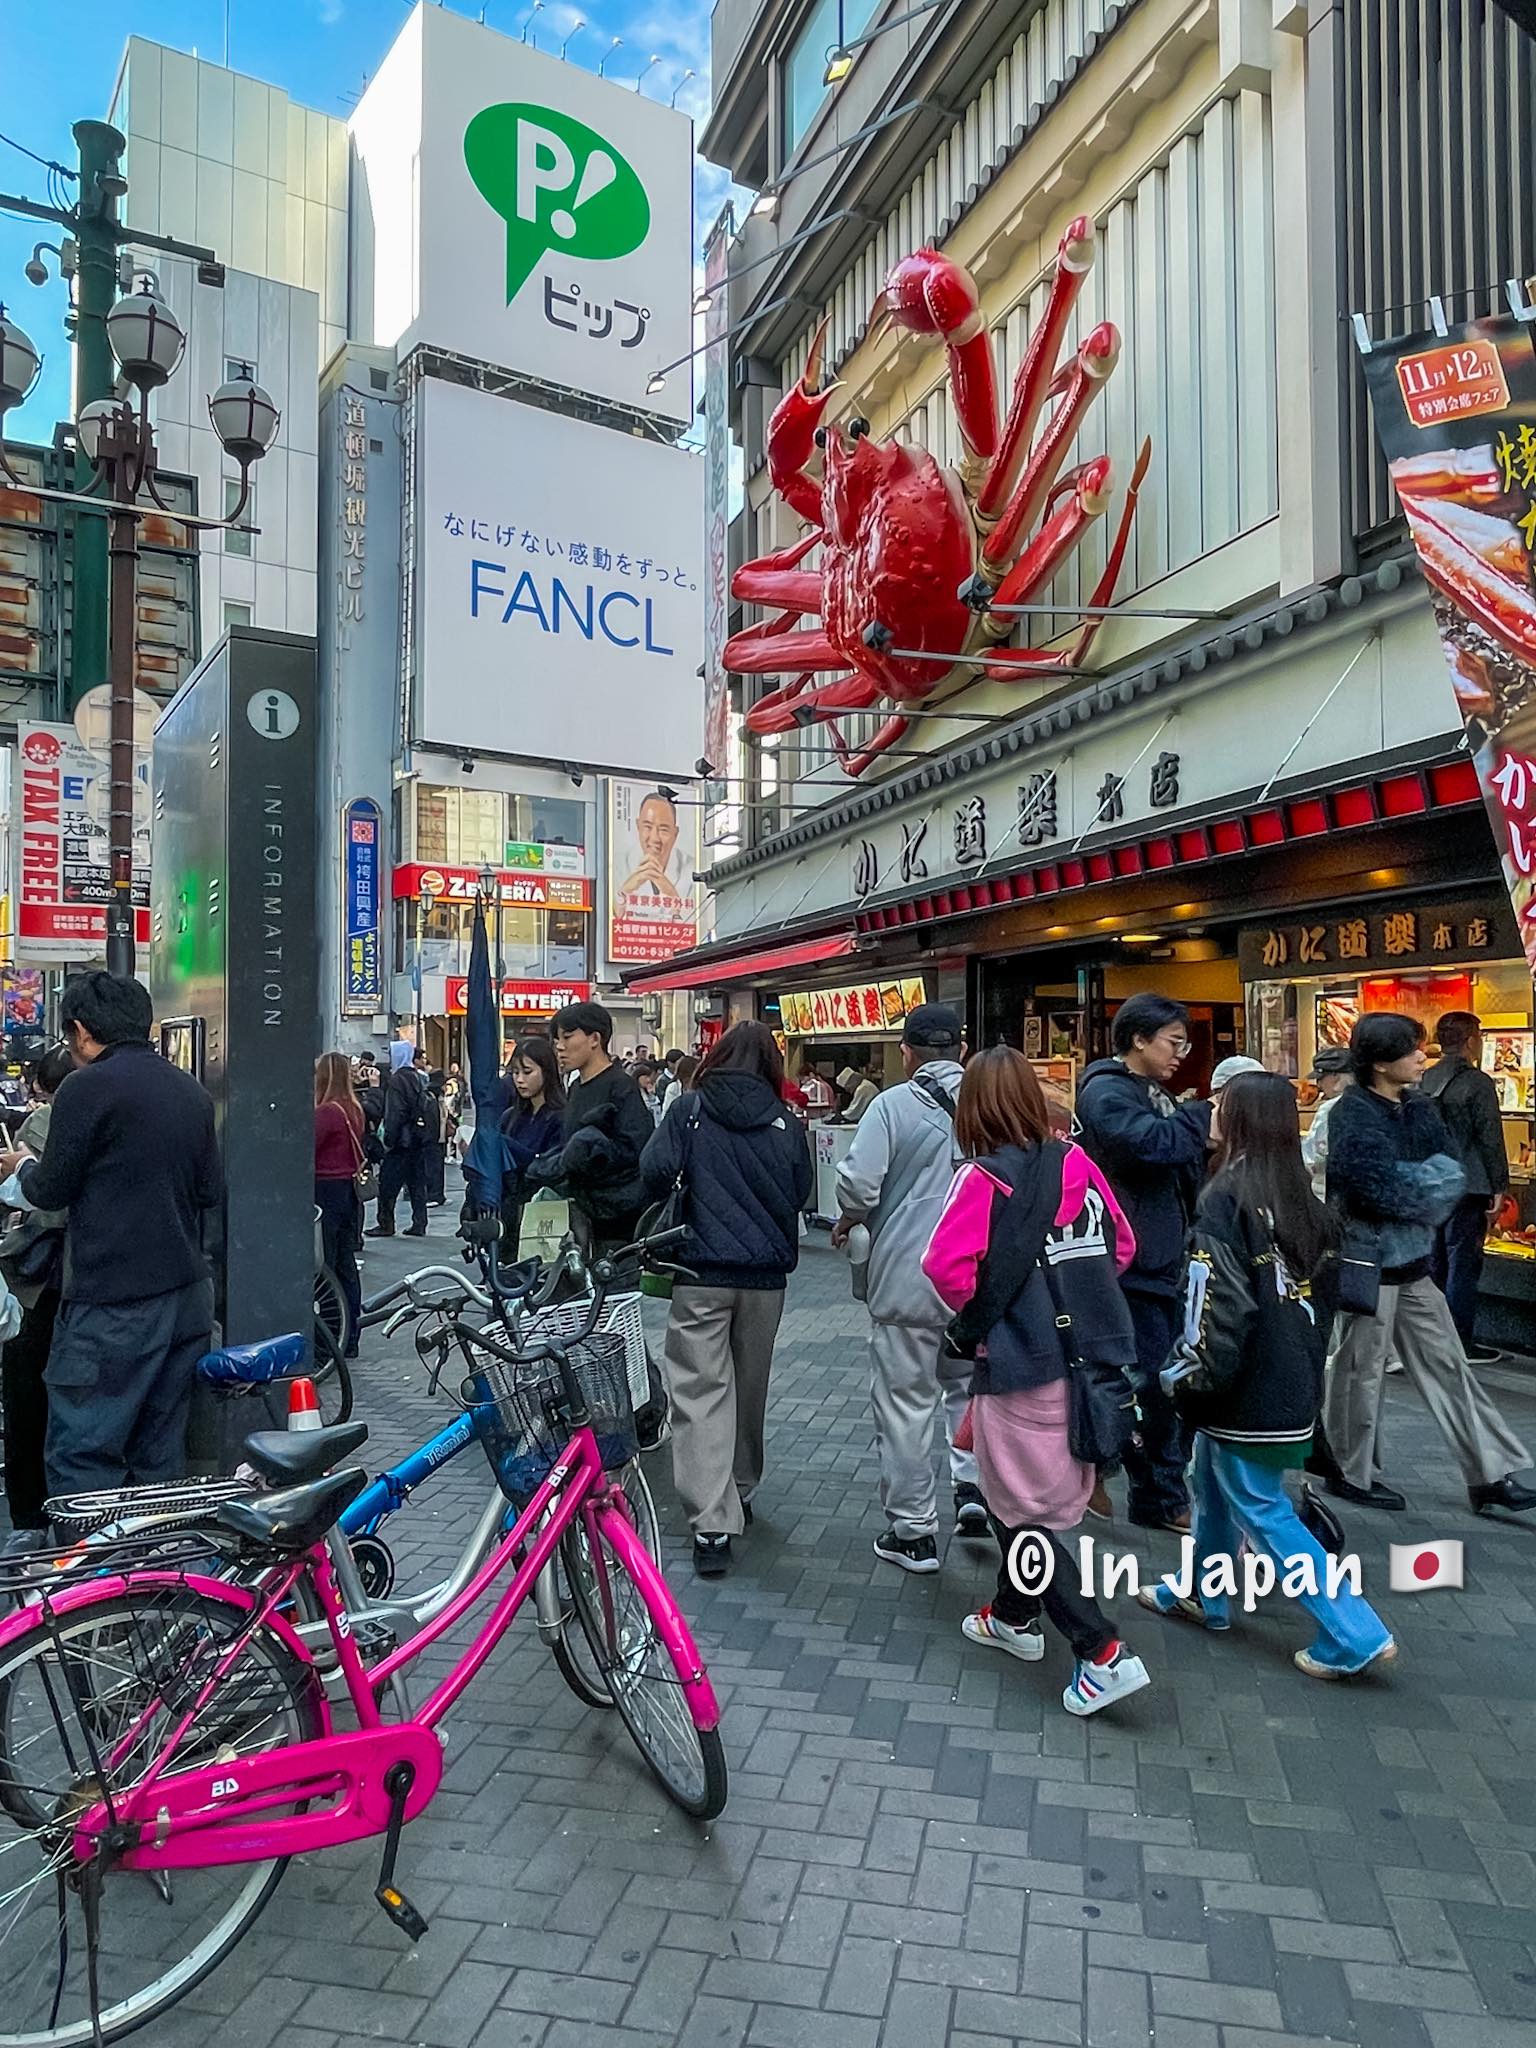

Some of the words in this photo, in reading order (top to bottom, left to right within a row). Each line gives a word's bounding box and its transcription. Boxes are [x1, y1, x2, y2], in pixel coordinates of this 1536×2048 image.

[544, 275, 651, 348] ピップ
[1418, 388, 1500, 418] 特別会席フェア
[344, 396, 366, 622] 道頓堀観光ビル
[443, 512, 698, 591] なにげない感動をずっと。
[472, 559, 674, 656] FANCL
[24, 768, 59, 825] TAX
[23, 831, 59, 903] FREE
[264, 785, 282, 1026] INFORMATION
